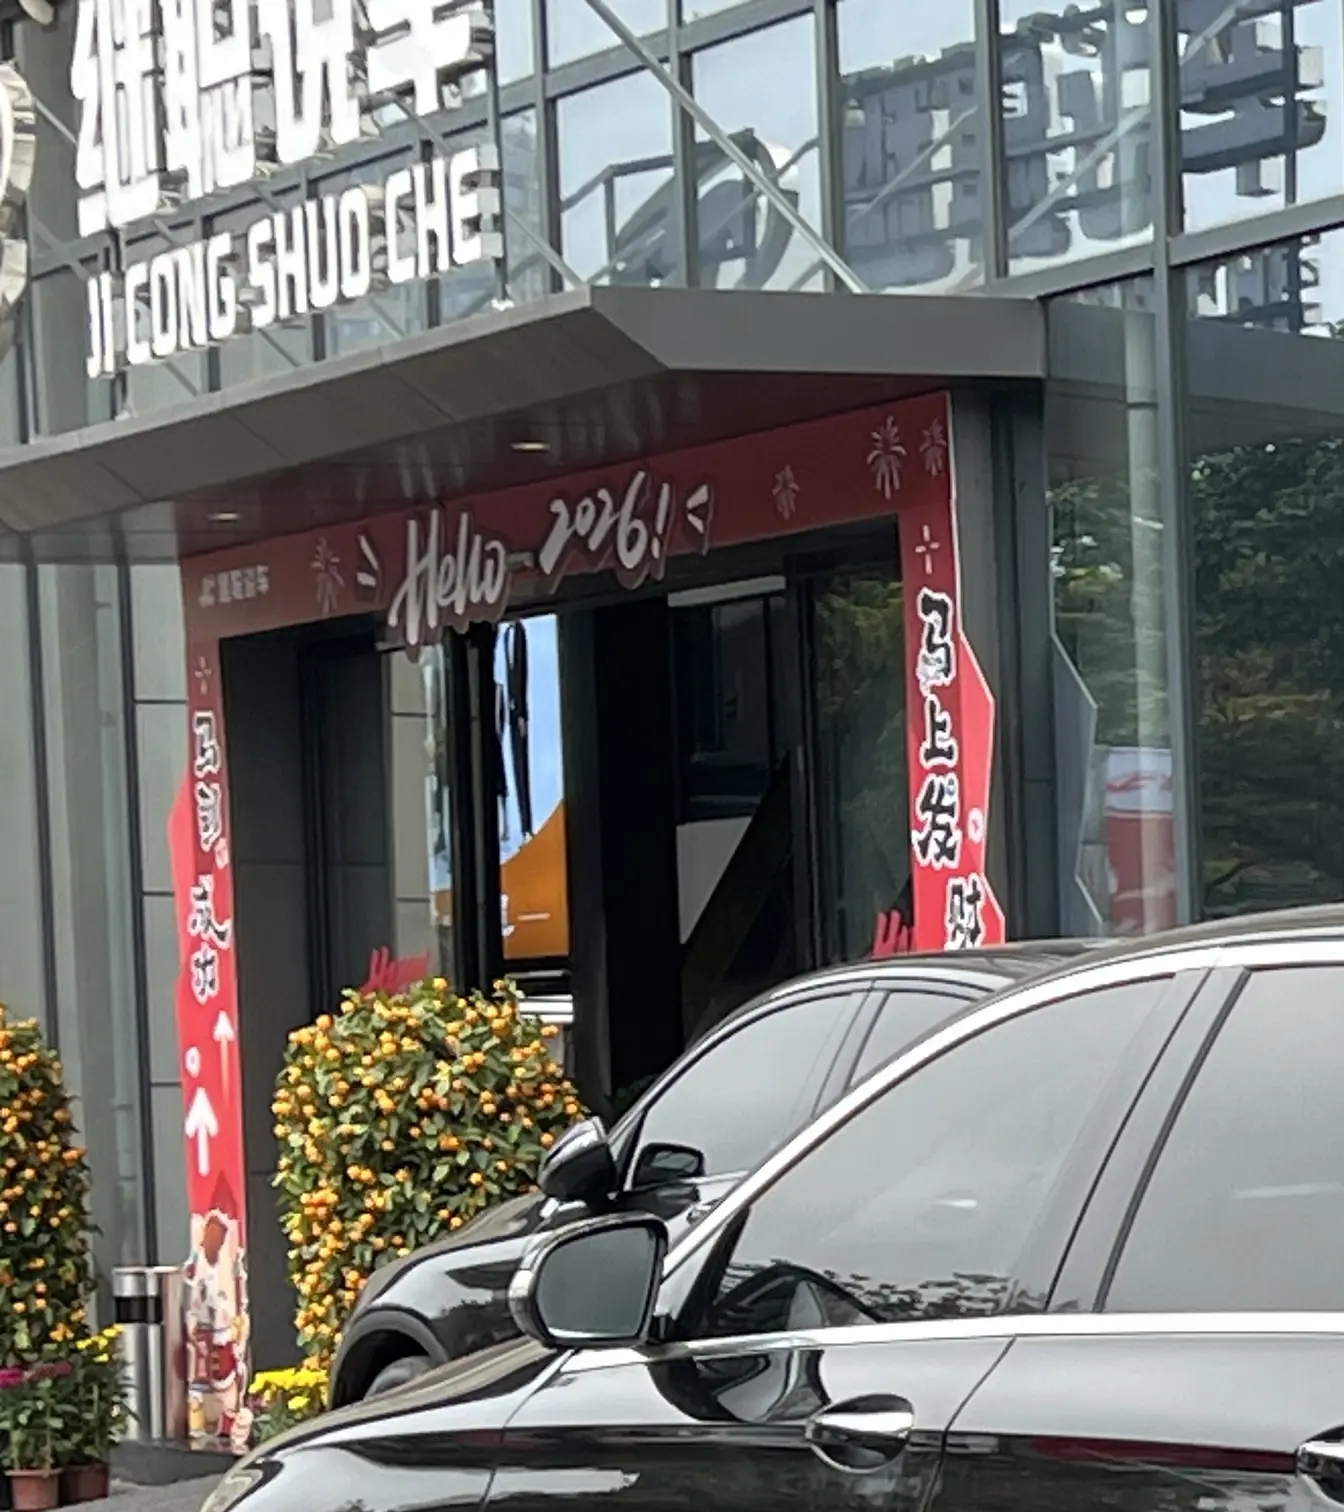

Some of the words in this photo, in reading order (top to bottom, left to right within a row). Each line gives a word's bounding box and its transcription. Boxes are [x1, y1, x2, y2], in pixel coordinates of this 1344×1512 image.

[87, 271, 115, 379] JI
[247, 186, 370, 327] SHUO
[385, 147, 482, 284] CHE
[912, 586, 986, 951] 马上发财
